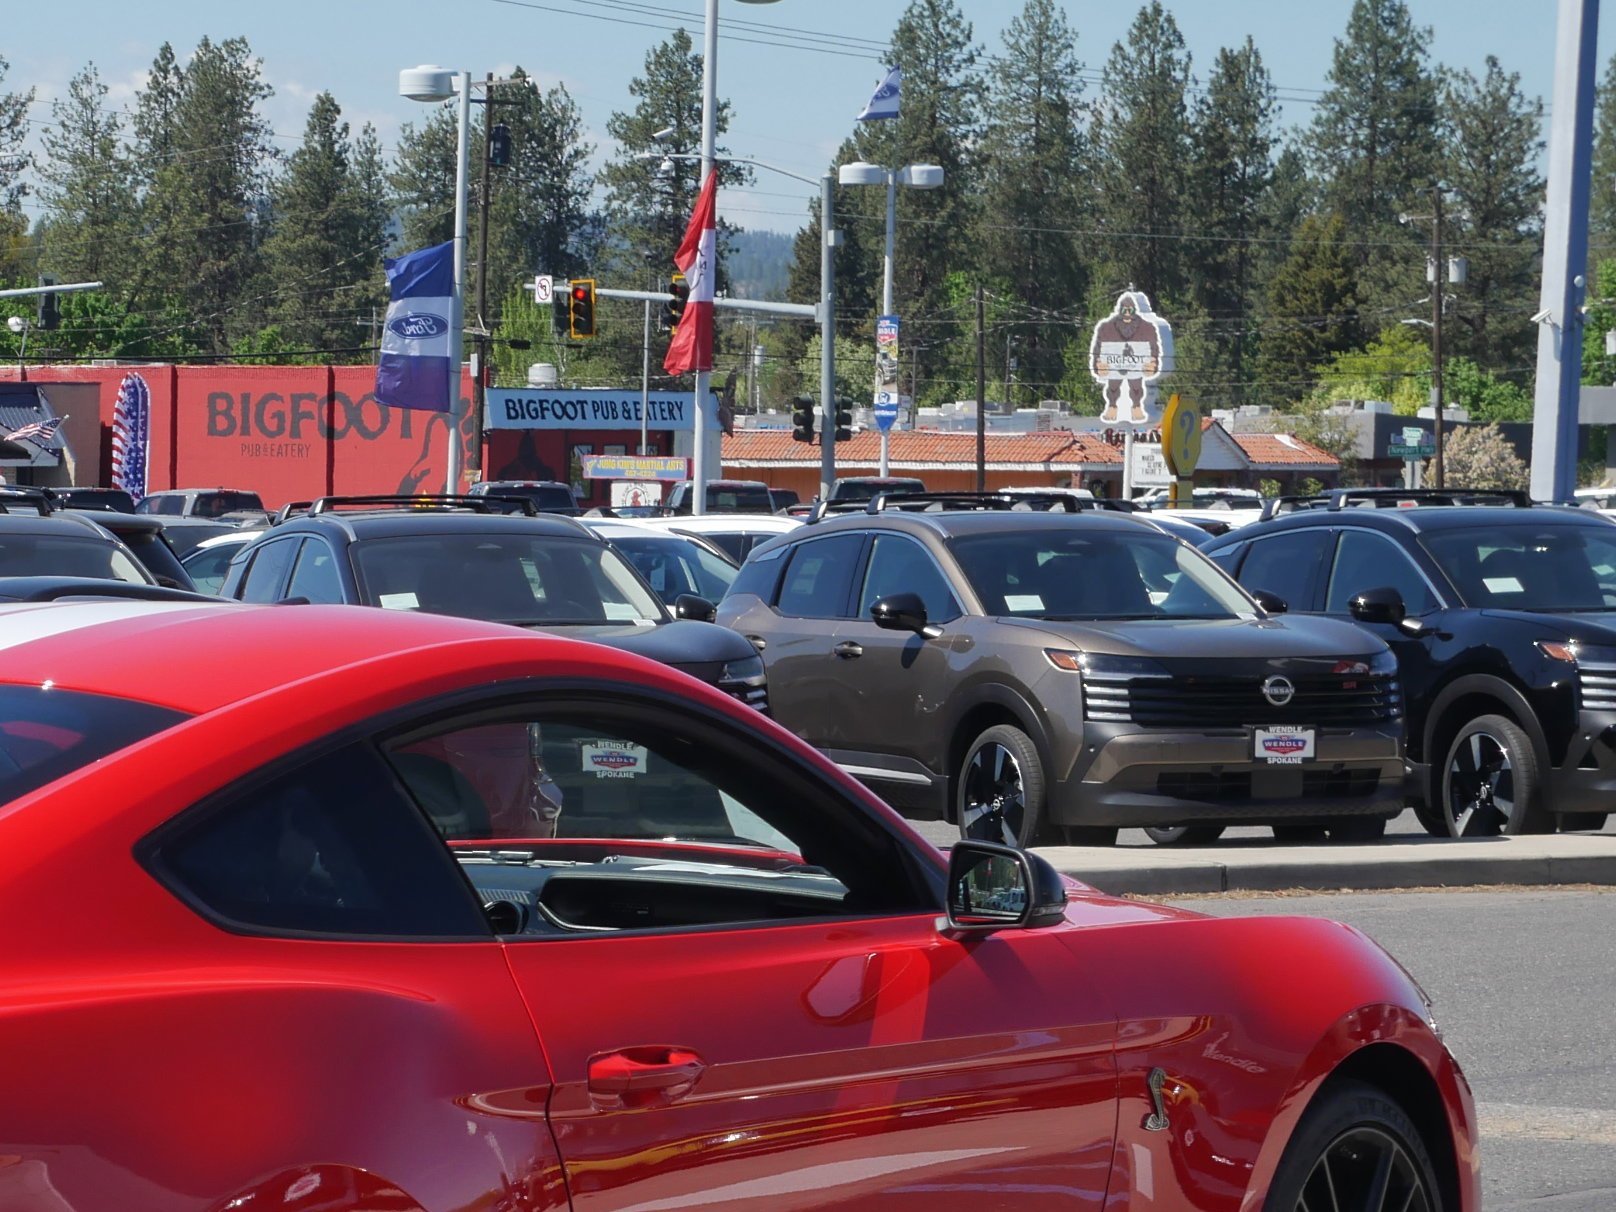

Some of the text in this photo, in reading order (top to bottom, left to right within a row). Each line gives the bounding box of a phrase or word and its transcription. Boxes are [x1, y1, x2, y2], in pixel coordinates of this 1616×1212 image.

[1106, 355, 1145, 364] BIGFOOT
[505, 398, 589, 421] BIGFOOT
[591, 400, 619, 421] PUB
[621, 400, 633, 421] &
[240, 443, 261, 457] PUB
[270, 443, 312, 458] EATERY
